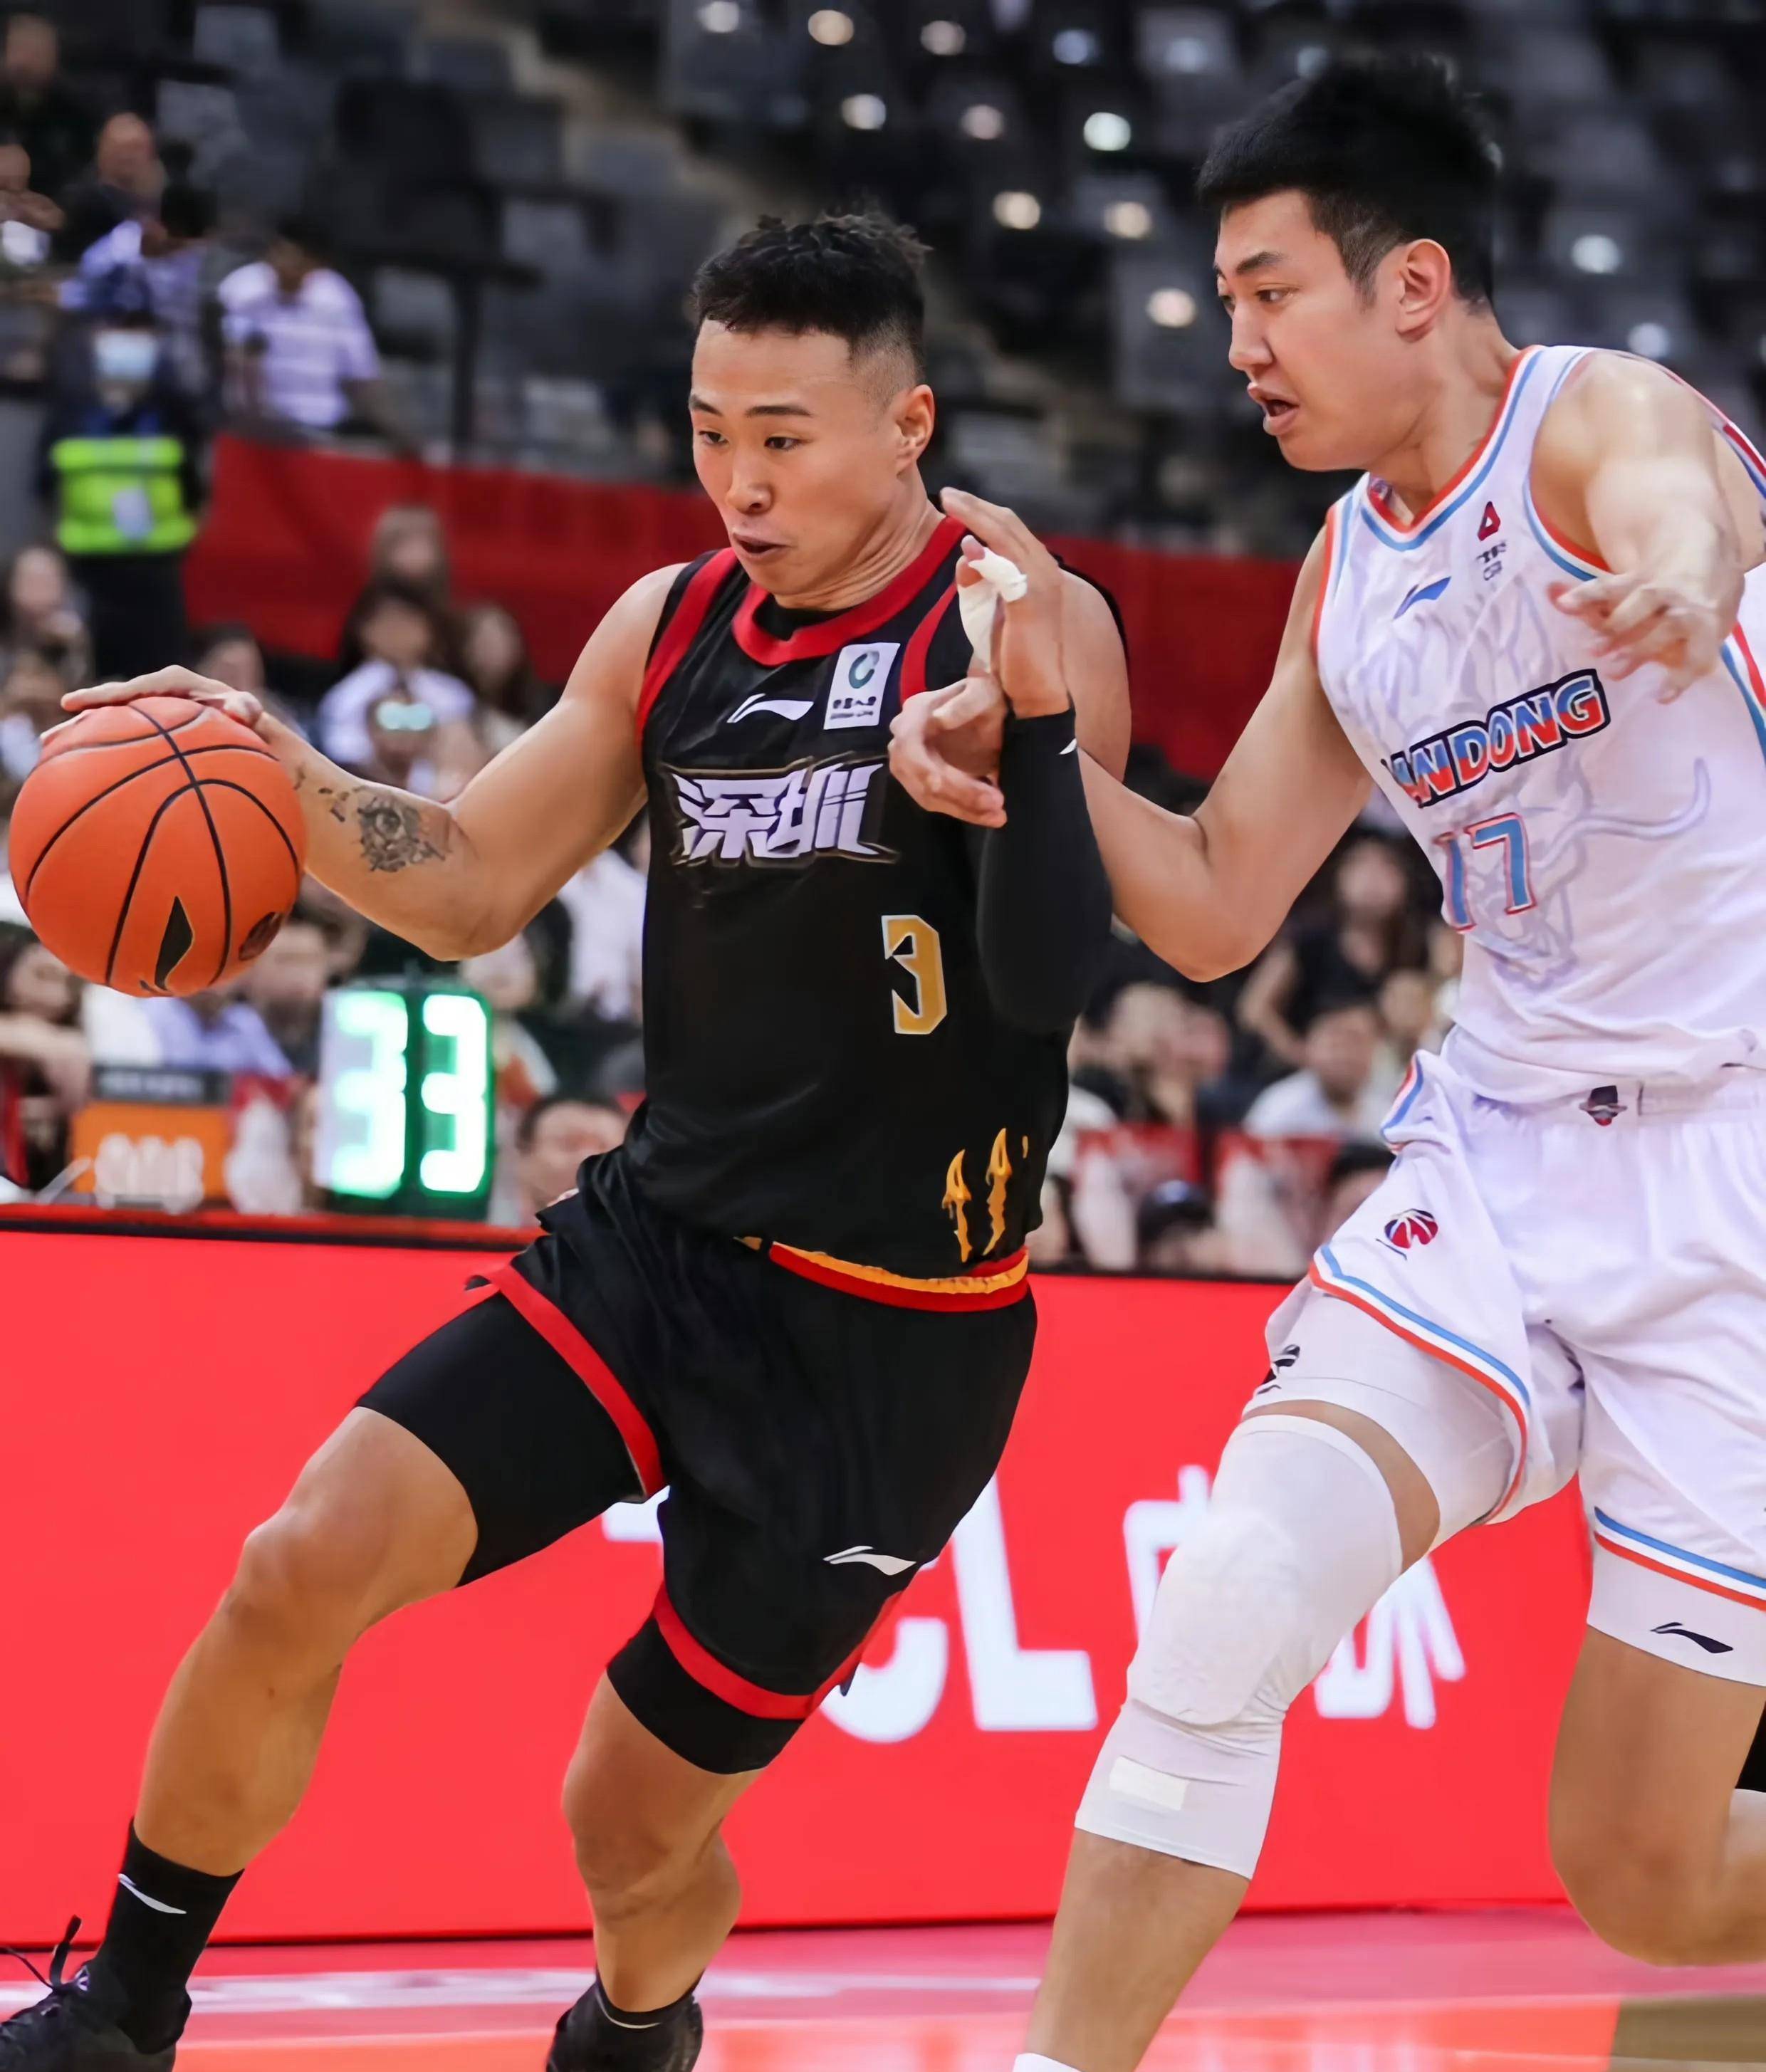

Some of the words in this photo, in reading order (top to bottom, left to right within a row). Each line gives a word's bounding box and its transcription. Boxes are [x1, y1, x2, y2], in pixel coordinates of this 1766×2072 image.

[672, 762, 884, 859] 深圳
[1432, 812, 1537, 932] 17
[881, 914, 948, 1035] 3
[330, 991, 488, 1195] 33
